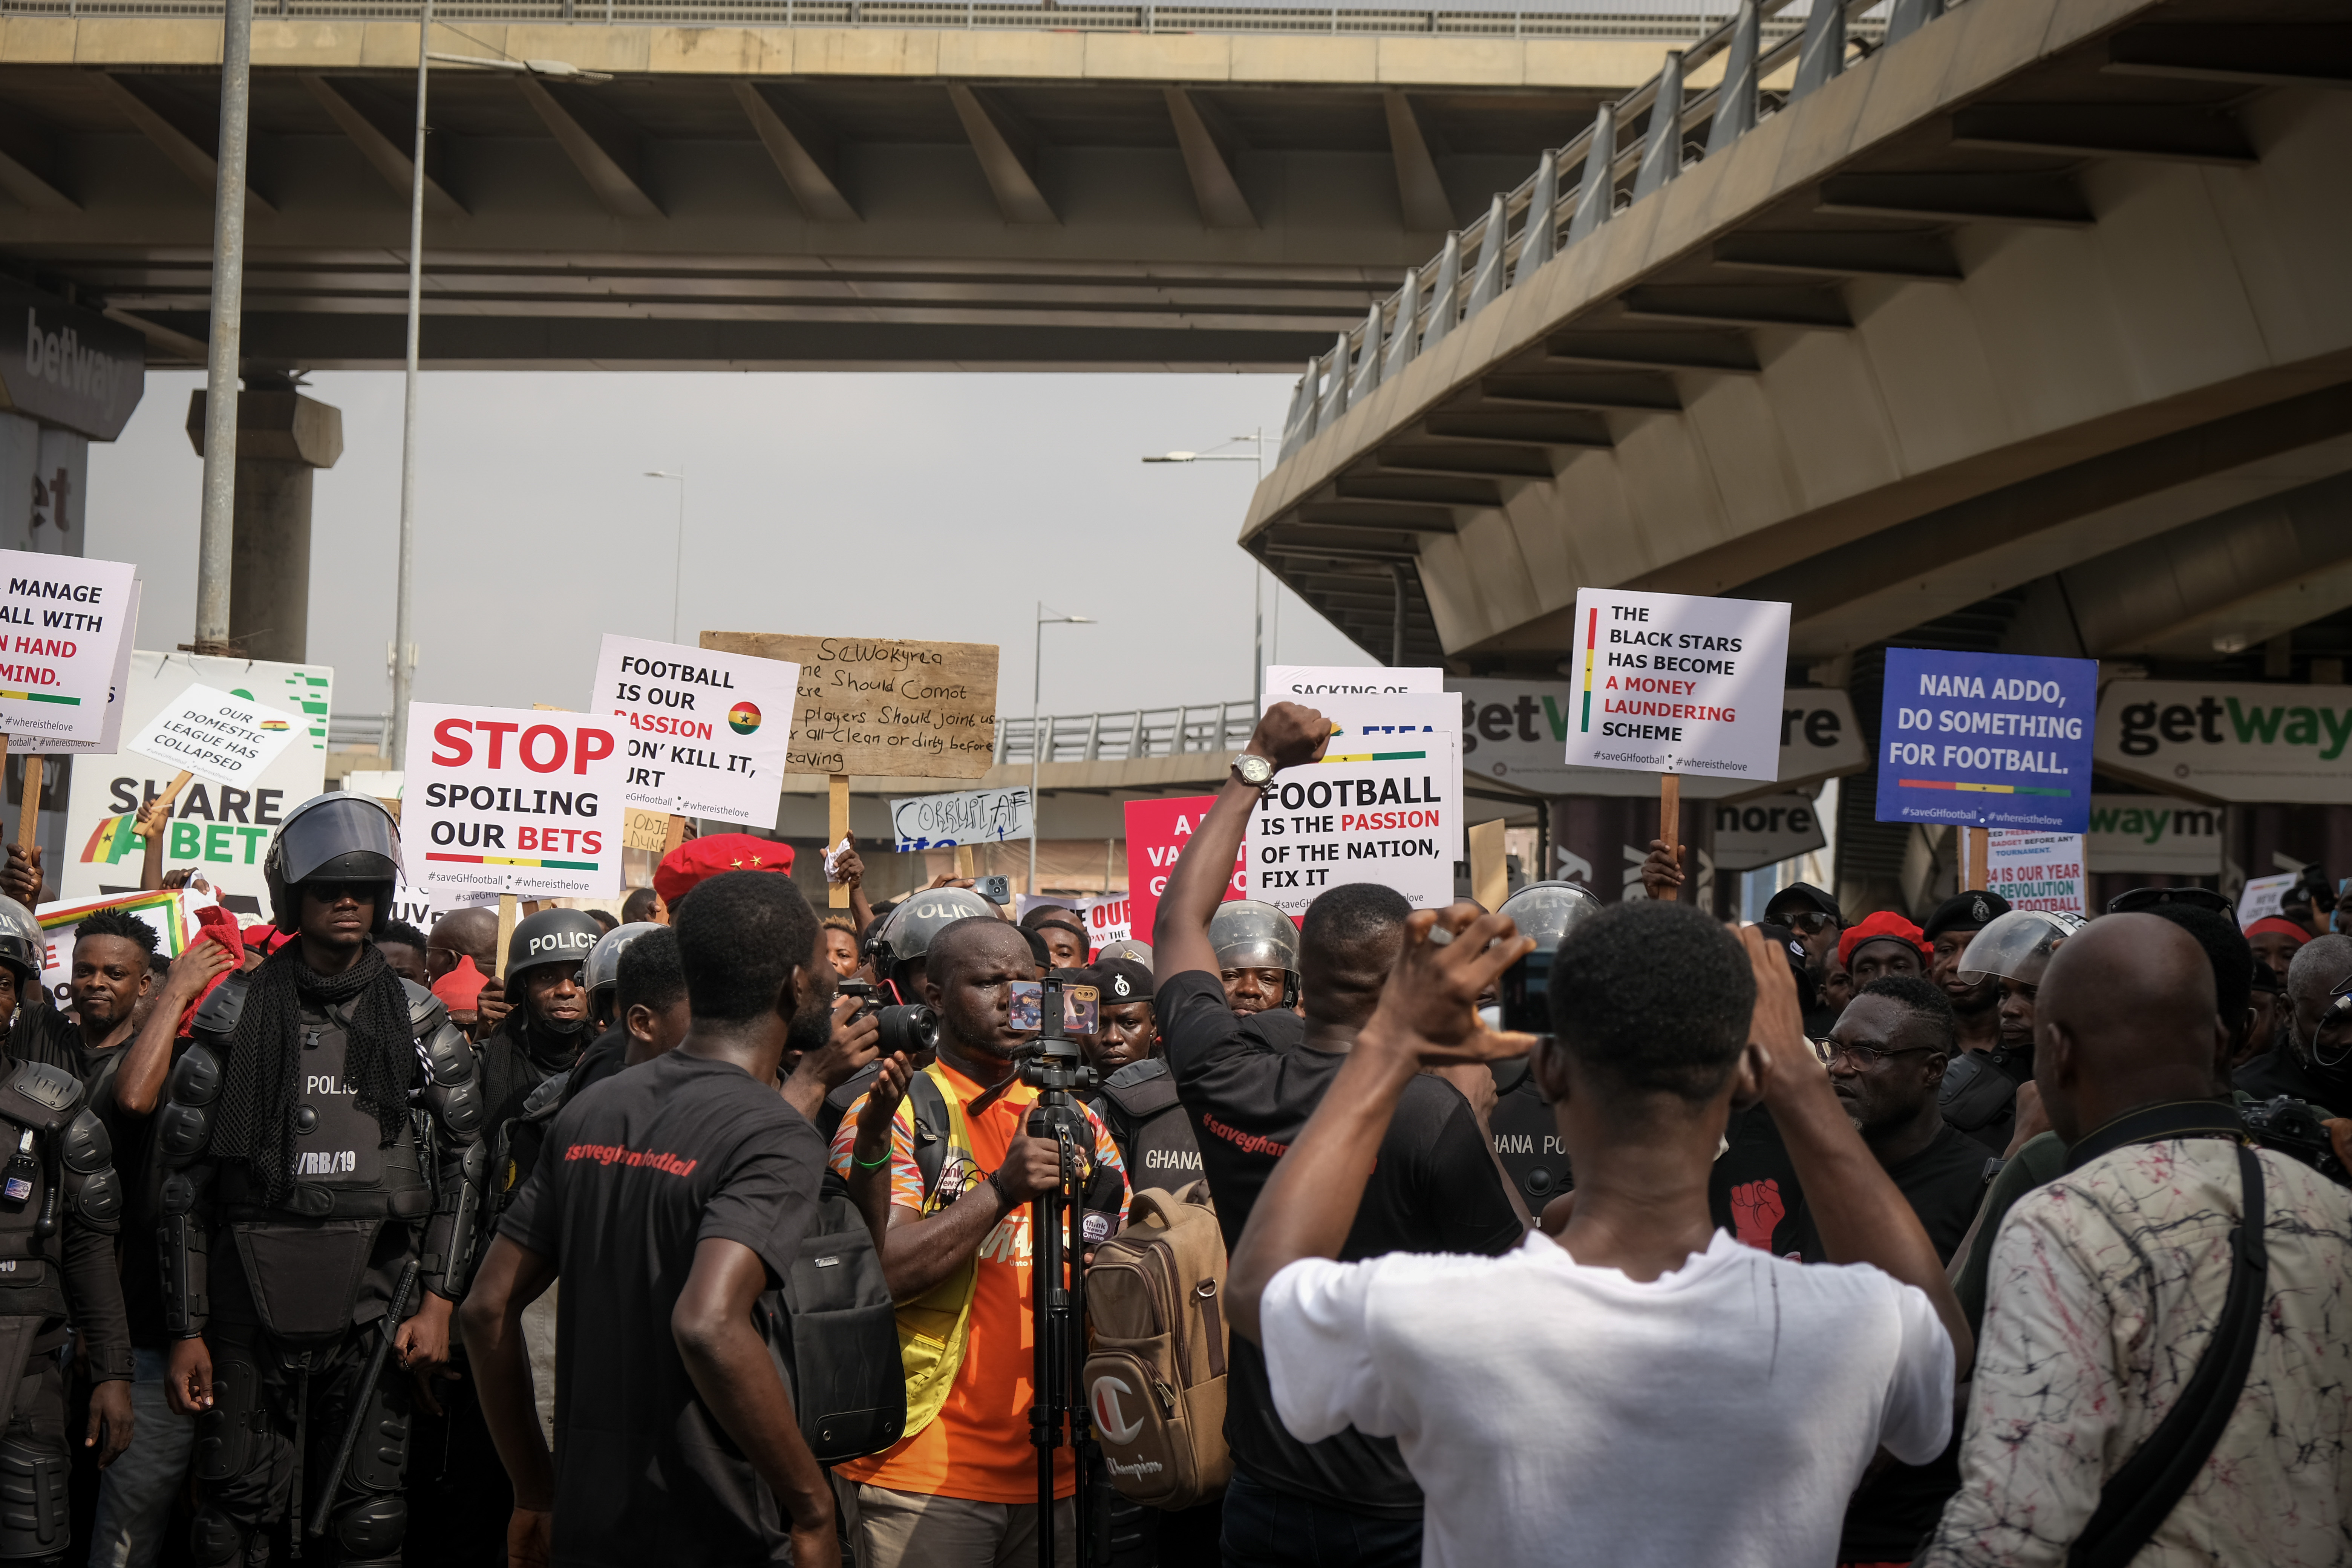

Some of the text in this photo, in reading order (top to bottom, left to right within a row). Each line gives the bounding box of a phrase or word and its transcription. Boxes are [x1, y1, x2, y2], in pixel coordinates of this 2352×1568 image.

[9, 577, 102, 603] MANAGE
[43, 610, 103, 632] WITH
[1611, 605, 1649, 622] THE
[15, 636, 77, 658] HAND
[1610, 629, 1743, 652] BLACK STARS
[621, 656, 734, 689] FOOTBALL
[1608, 653, 1735, 676] HAS BECOME
[831, 670, 895, 692] Should
[1605, 676, 1697, 696] A MONEY
[1920, 674, 2066, 708] NANA ADDO,
[616, 683, 695, 710] IS OUR
[219, 707, 253, 723] OUR
[805, 707, 866, 733] players
[980, 715, 995, 724] us
[1604, 698, 1736, 723] LAUNDERING
[5, 716, 73, 731] #whereisthelove
[183, 711, 265, 743] DOMESTIC
[1602, 722, 1683, 742] SCHEME
[1898, 708, 2082, 740] DO SOMETHING
[163, 720, 259, 758] LEAGUE HAS
[431, 718, 614, 775] STOP
[887, 736, 910, 746] or
[912, 732, 943, 754] dirty
[154, 735, 242, 770] COLLAPSED
[671, 746, 720, 769] KILL
[727, 755, 756, 778] IT,
[786, 752, 843, 772] eaving
[1593, 751, 1747, 772] #saveGHfootball #whereisthelove
[1889, 743, 2069, 775] FOR FOOTBALL.
[425, 783, 598, 817] SPOILING
[1262, 776, 1441, 811] FOOTBALL
[683, 801, 749, 818] #whereisthelove
[1902, 807, 2063, 826] #saveGHfootball #whereisthelove
[1262, 810, 1439, 835] IS THE PASSION
[170, 822, 267, 864] BET
[431, 821, 602, 854] OUR BETS
[1262, 846, 1290, 864] OF
[1297, 844, 1339, 862] THE
[1348, 839, 1439, 859] NATION,
[428, 871, 589, 891] #saveGHfootball #whereisthelove
[1262, 870, 1298, 888] FIX
[1306, 869, 1329, 885] IT
[2002, 867, 2013, 882] IS
[2017, 866, 2043, 881] OUR
[2047, 863, 2080, 879] YEAR
[2000, 880, 2074, 899] REVOLUTION
[2017, 897, 2081, 911] FOOTBALL
[529, 932, 597, 956] POLICE
[1108, 930, 1126, 939] THE
[296, 1151, 355, 1175] /RB/19
[1146, 1150, 1203, 1171] GHANA
[1086, 1219, 1106, 1230] think
[1083, 1232, 1104, 1241] Online
[1107, 1454, 1162, 1482] Champion
